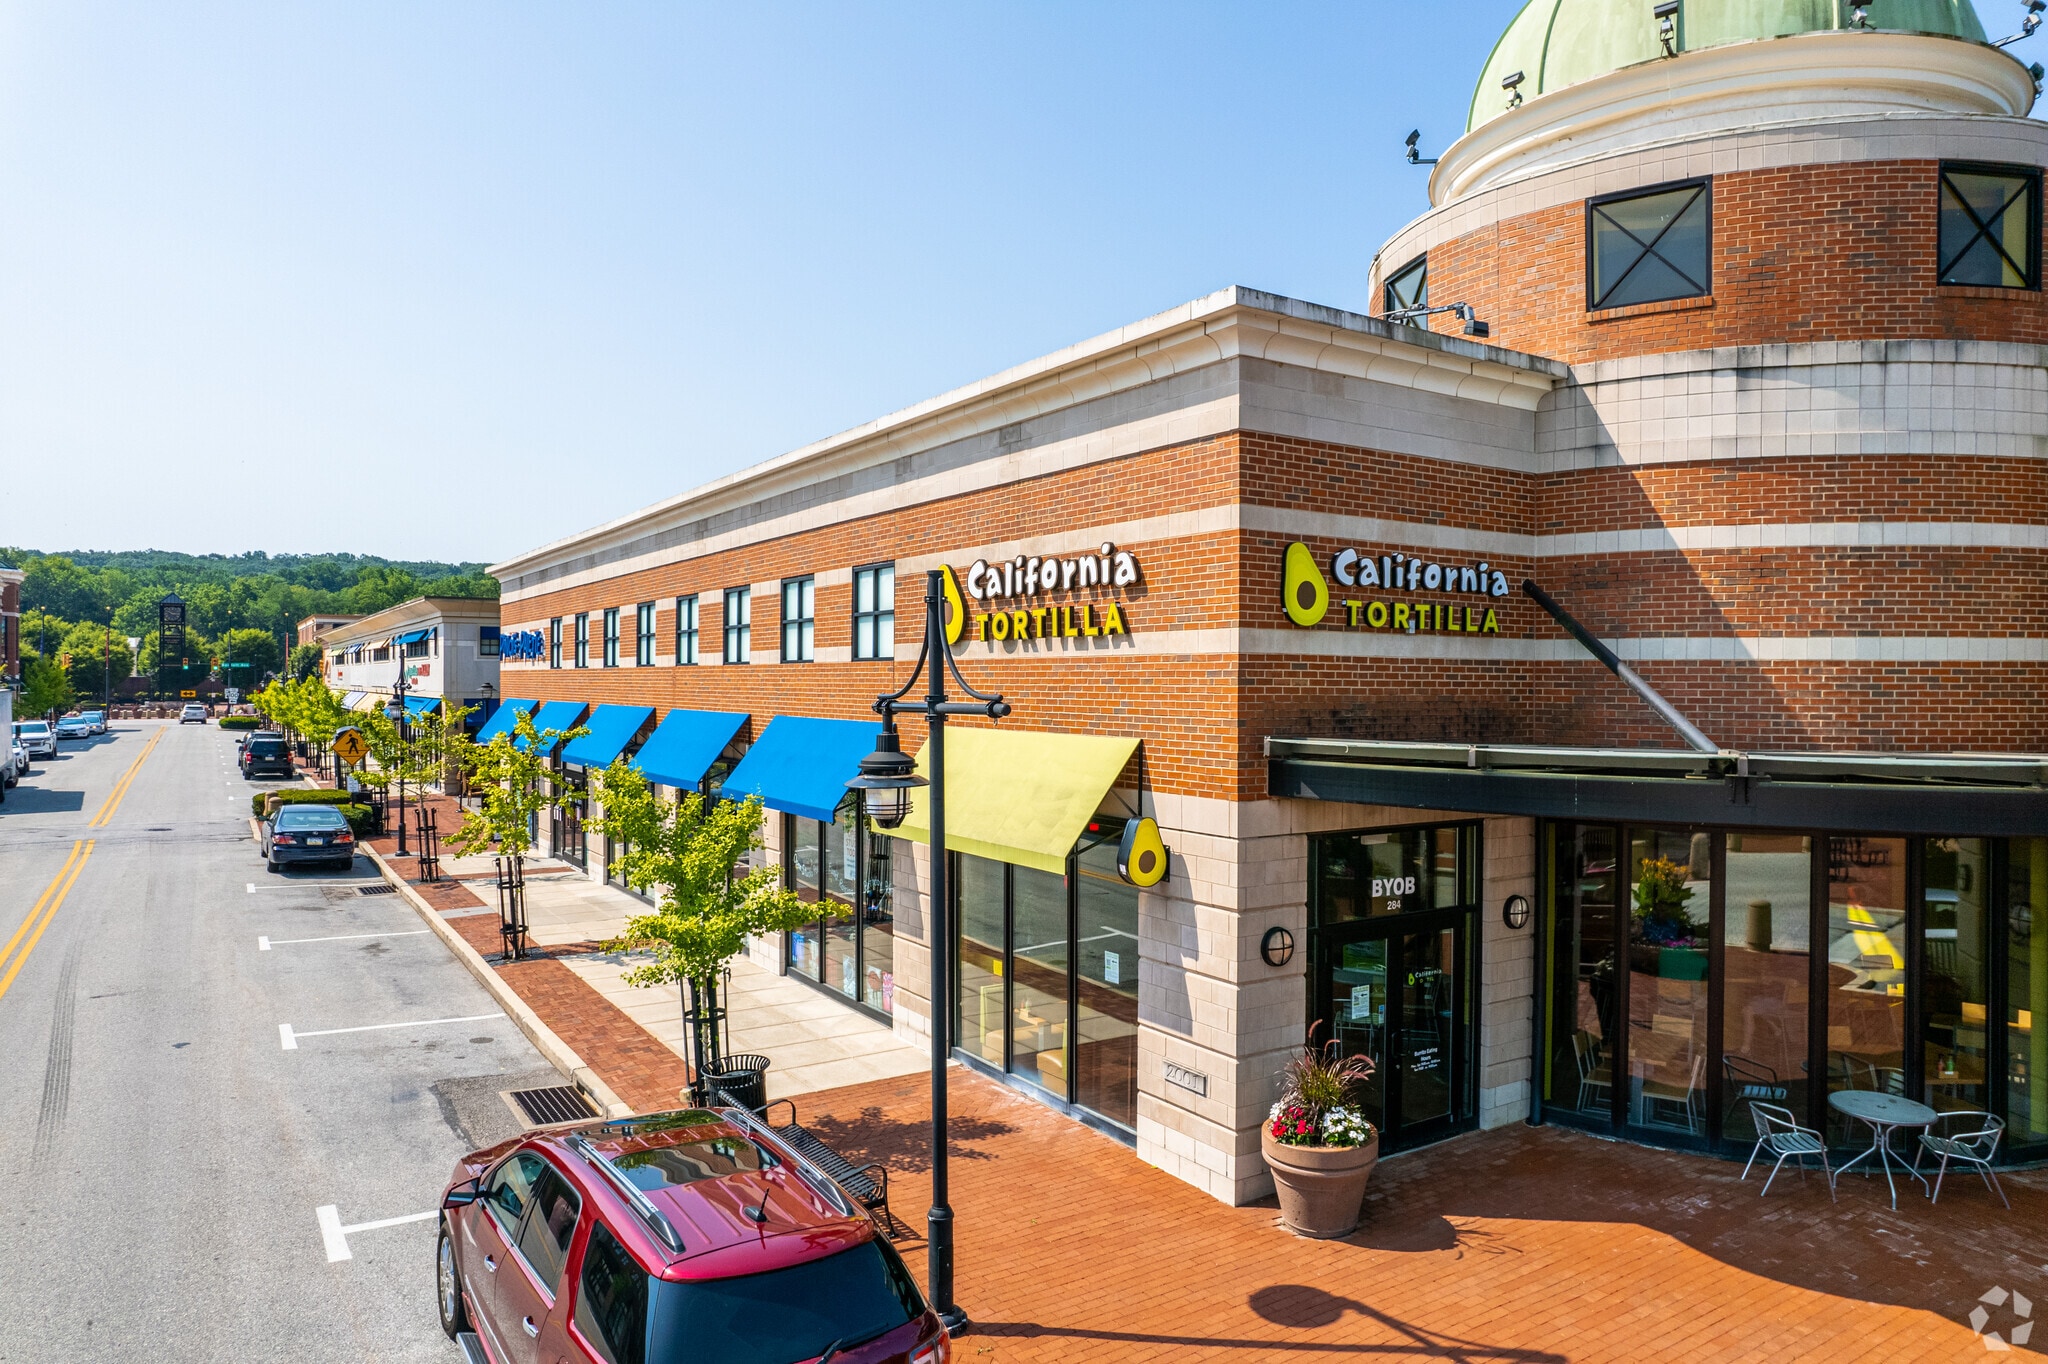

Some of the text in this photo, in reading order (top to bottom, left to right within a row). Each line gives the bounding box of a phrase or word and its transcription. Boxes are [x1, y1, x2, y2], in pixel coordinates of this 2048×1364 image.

[967, 542, 1140, 599] California
[1331, 547, 1509, 597] California
[976, 602, 1127, 642] TORTILLA
[1344, 599, 1499, 633] TORTILLA
[1372, 877, 1415, 897] BYOB
[1387, 900, 1401, 910] 284
[1415, 968, 1442, 978] California
[1167, 1064, 1200, 1090] 2001
